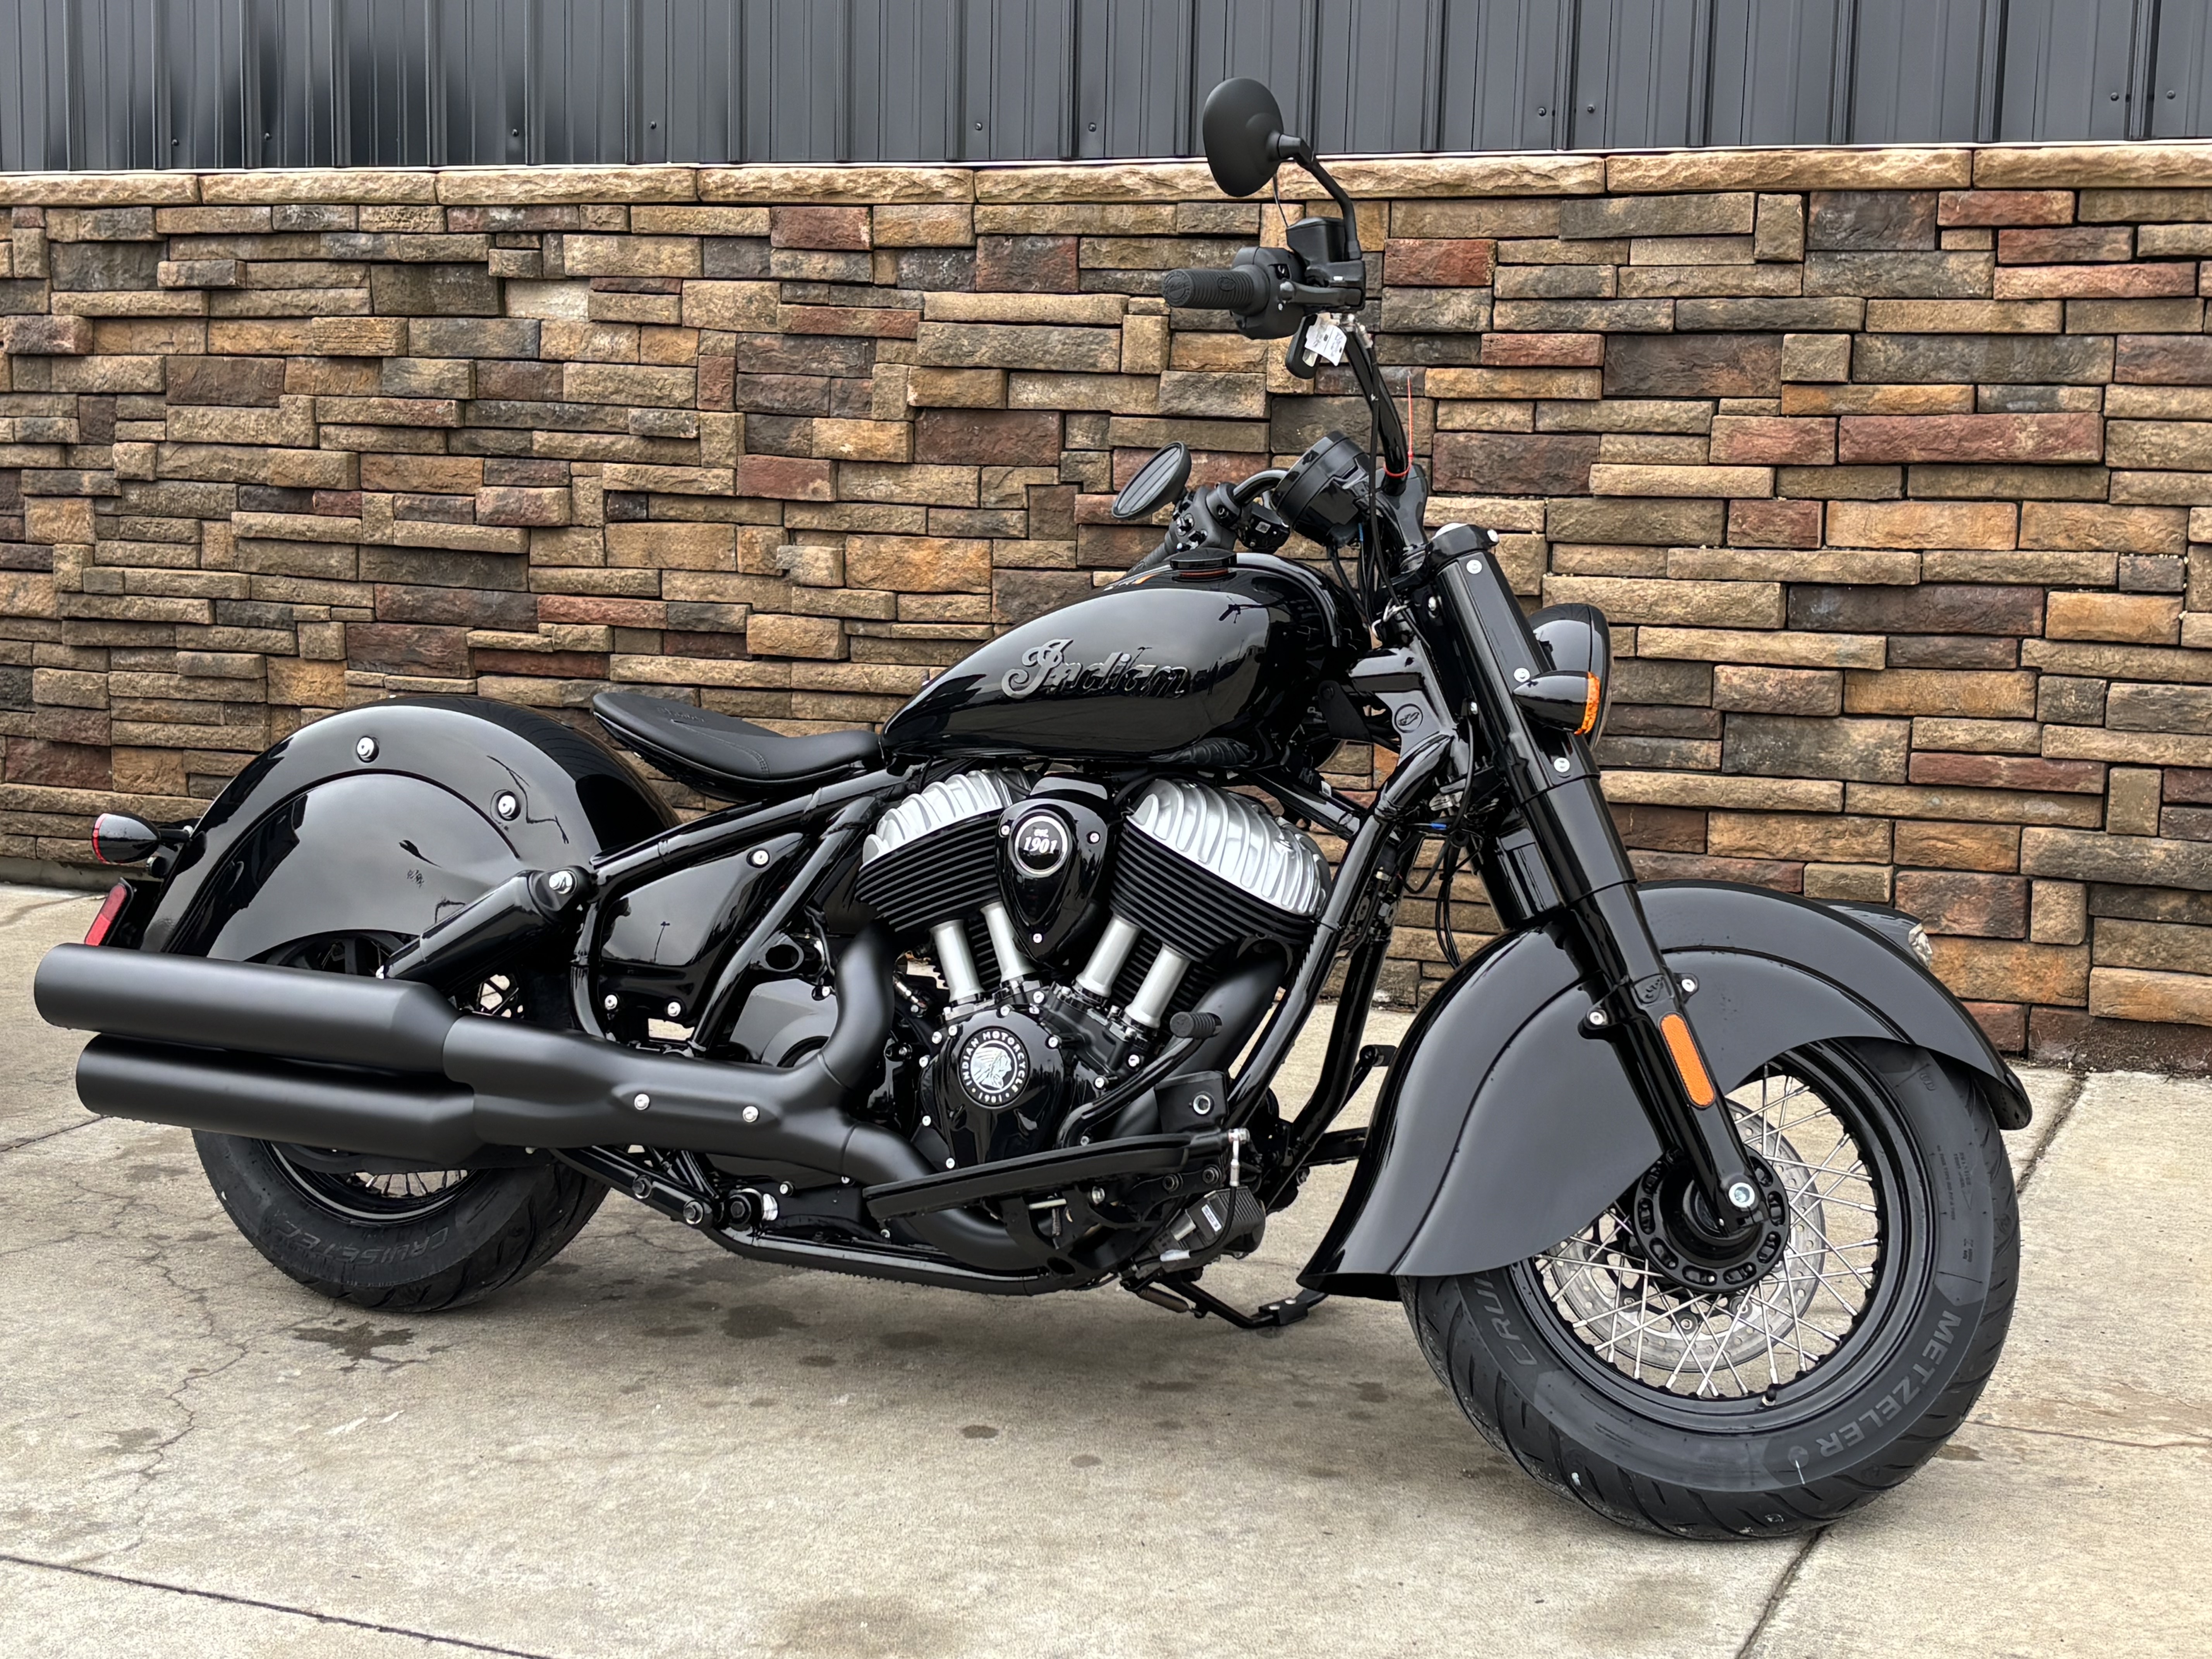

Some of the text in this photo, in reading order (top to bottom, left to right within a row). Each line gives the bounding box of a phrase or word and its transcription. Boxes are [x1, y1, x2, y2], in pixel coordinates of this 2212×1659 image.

[1001, 639, 1191, 699] Indian
[1023, 836, 1058, 854] 1901
[962, 1030, 1026, 1093] INDIAN MOTORCYCLE
[978, 1092, 1003, 1103] 1901
[1474, 1271, 1537, 1365] CRUI
[1816, 1310, 1962, 1457] METZELER
